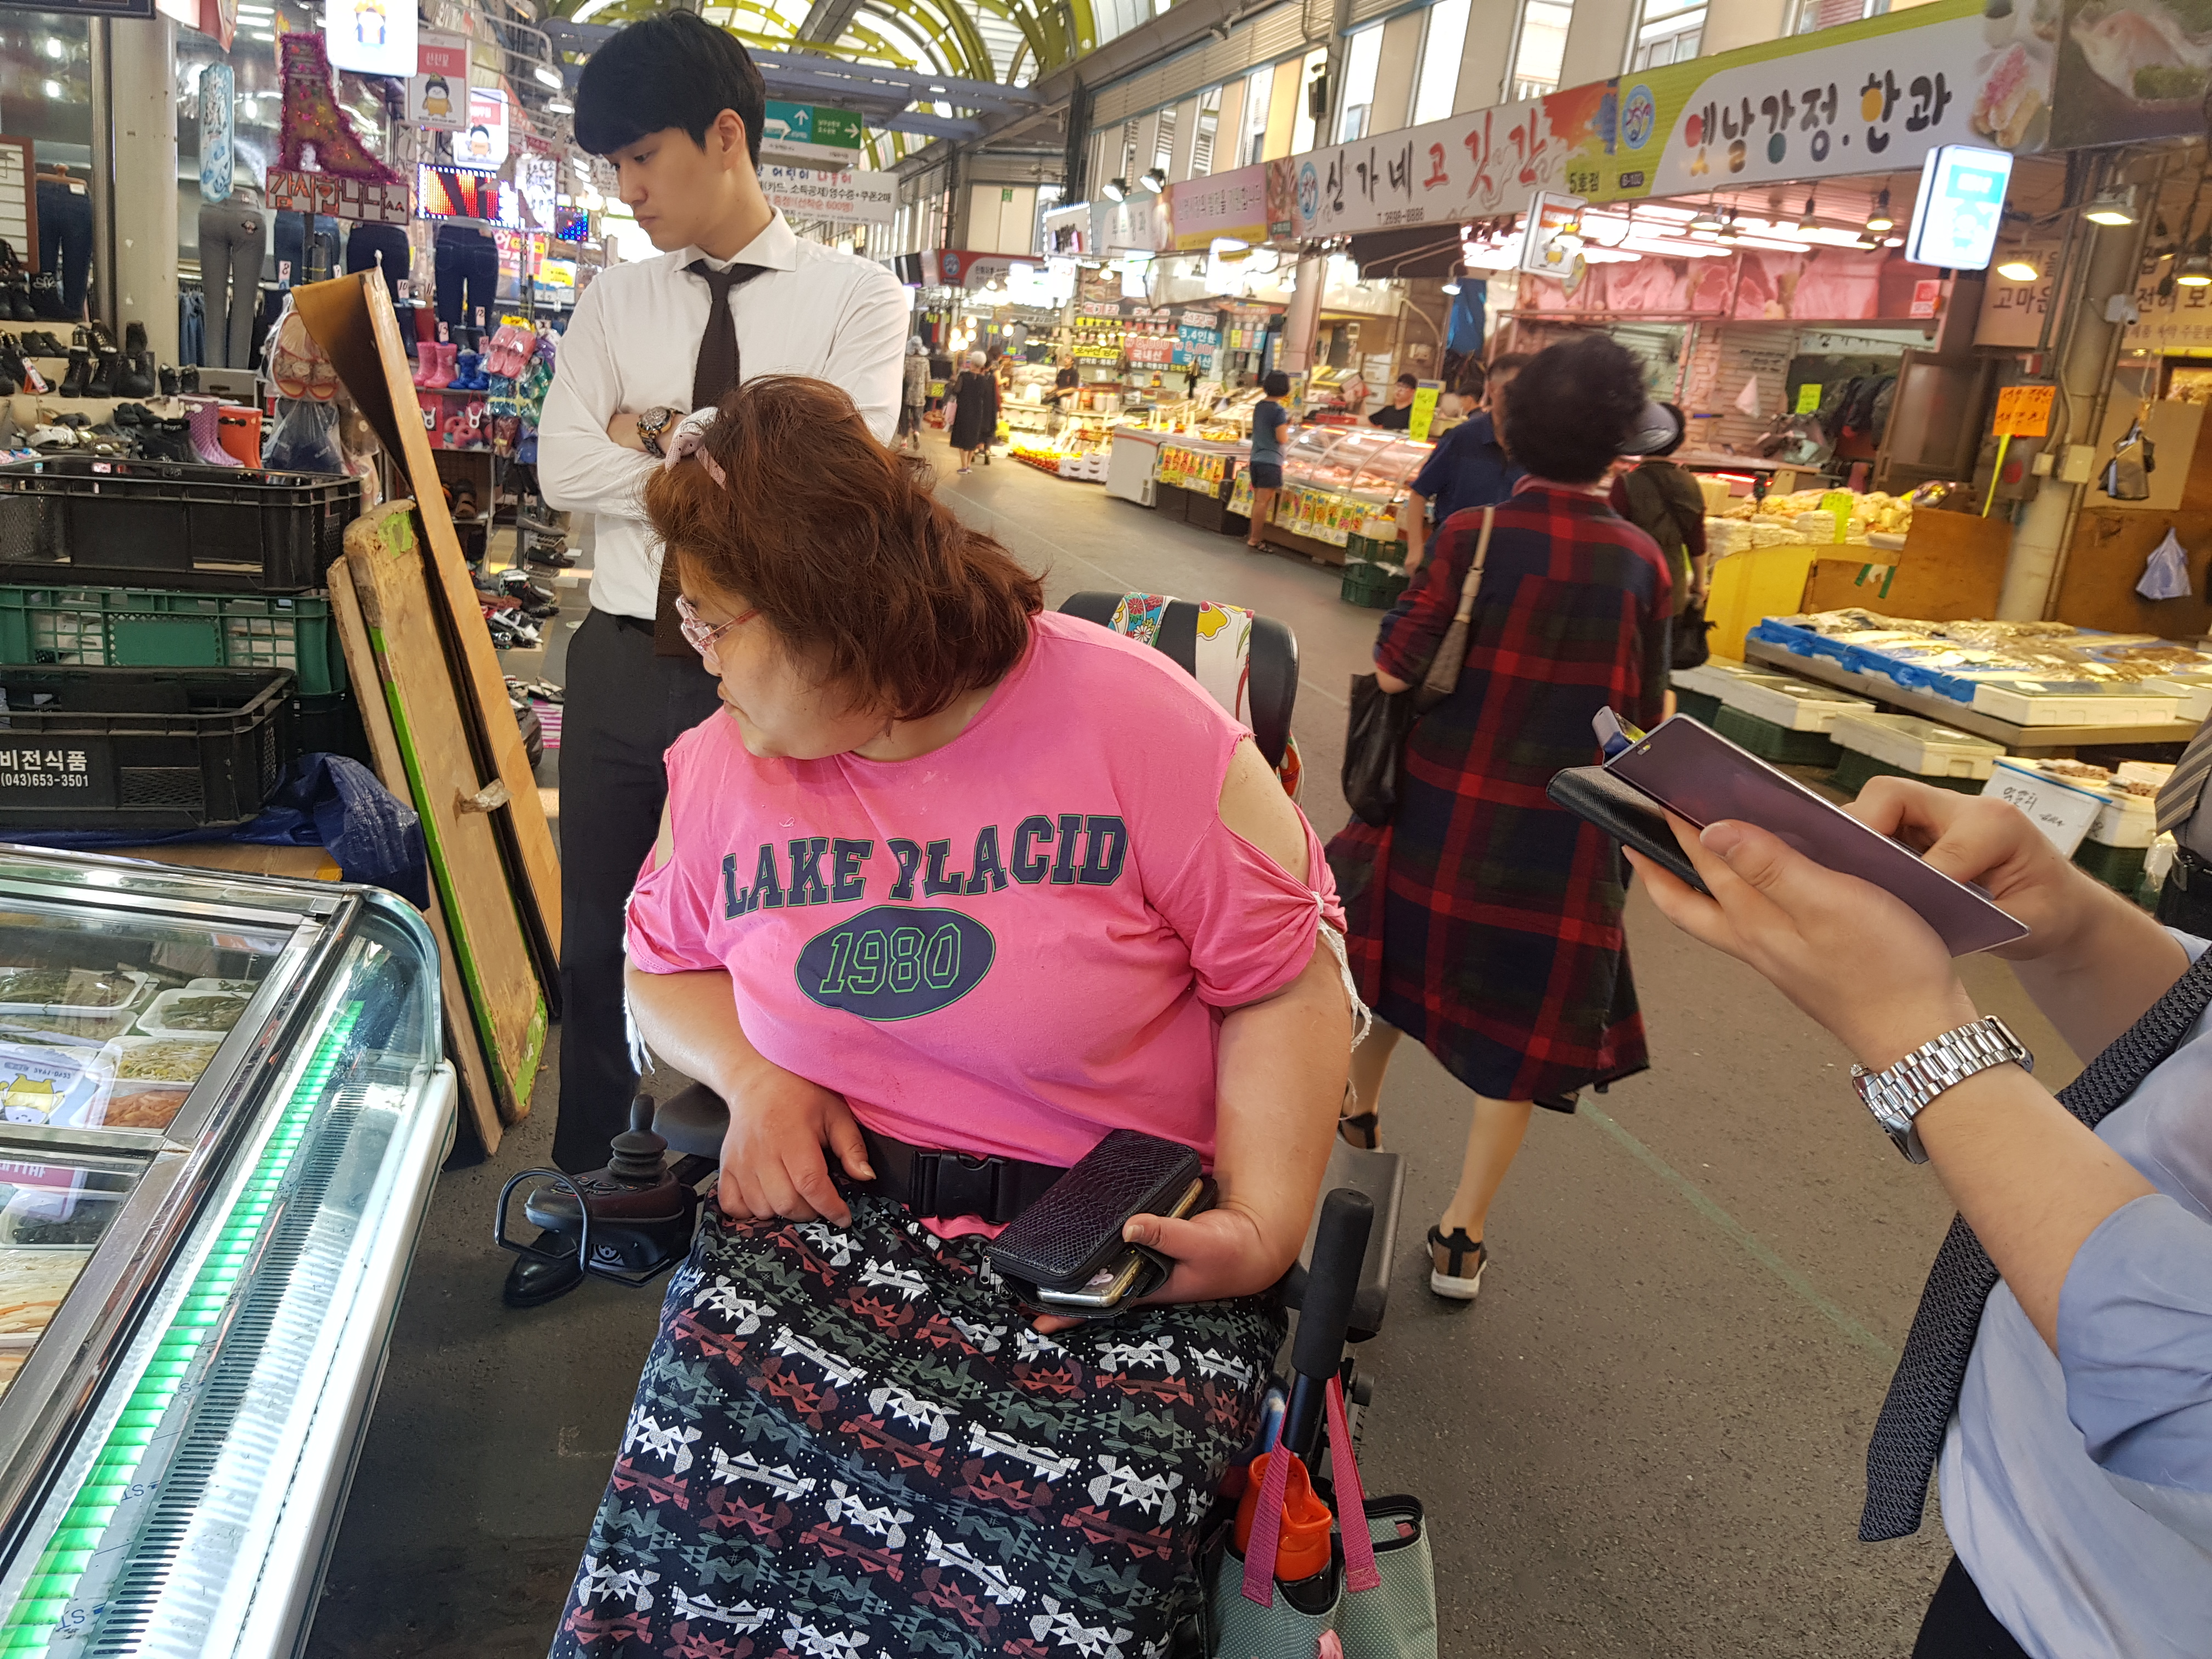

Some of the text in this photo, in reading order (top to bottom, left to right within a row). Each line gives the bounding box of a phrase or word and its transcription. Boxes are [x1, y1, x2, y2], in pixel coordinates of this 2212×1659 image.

[772, 167, 810, 180] 어린이
[1133, 349, 1164, 362] 국내산
[0, 749, 88, 772] 비전식품
[1, 772, 89, 788] (043)653-3501
[722, 813, 1127, 921] LAKE PLACID
[819, 922, 962, 995] 1980
